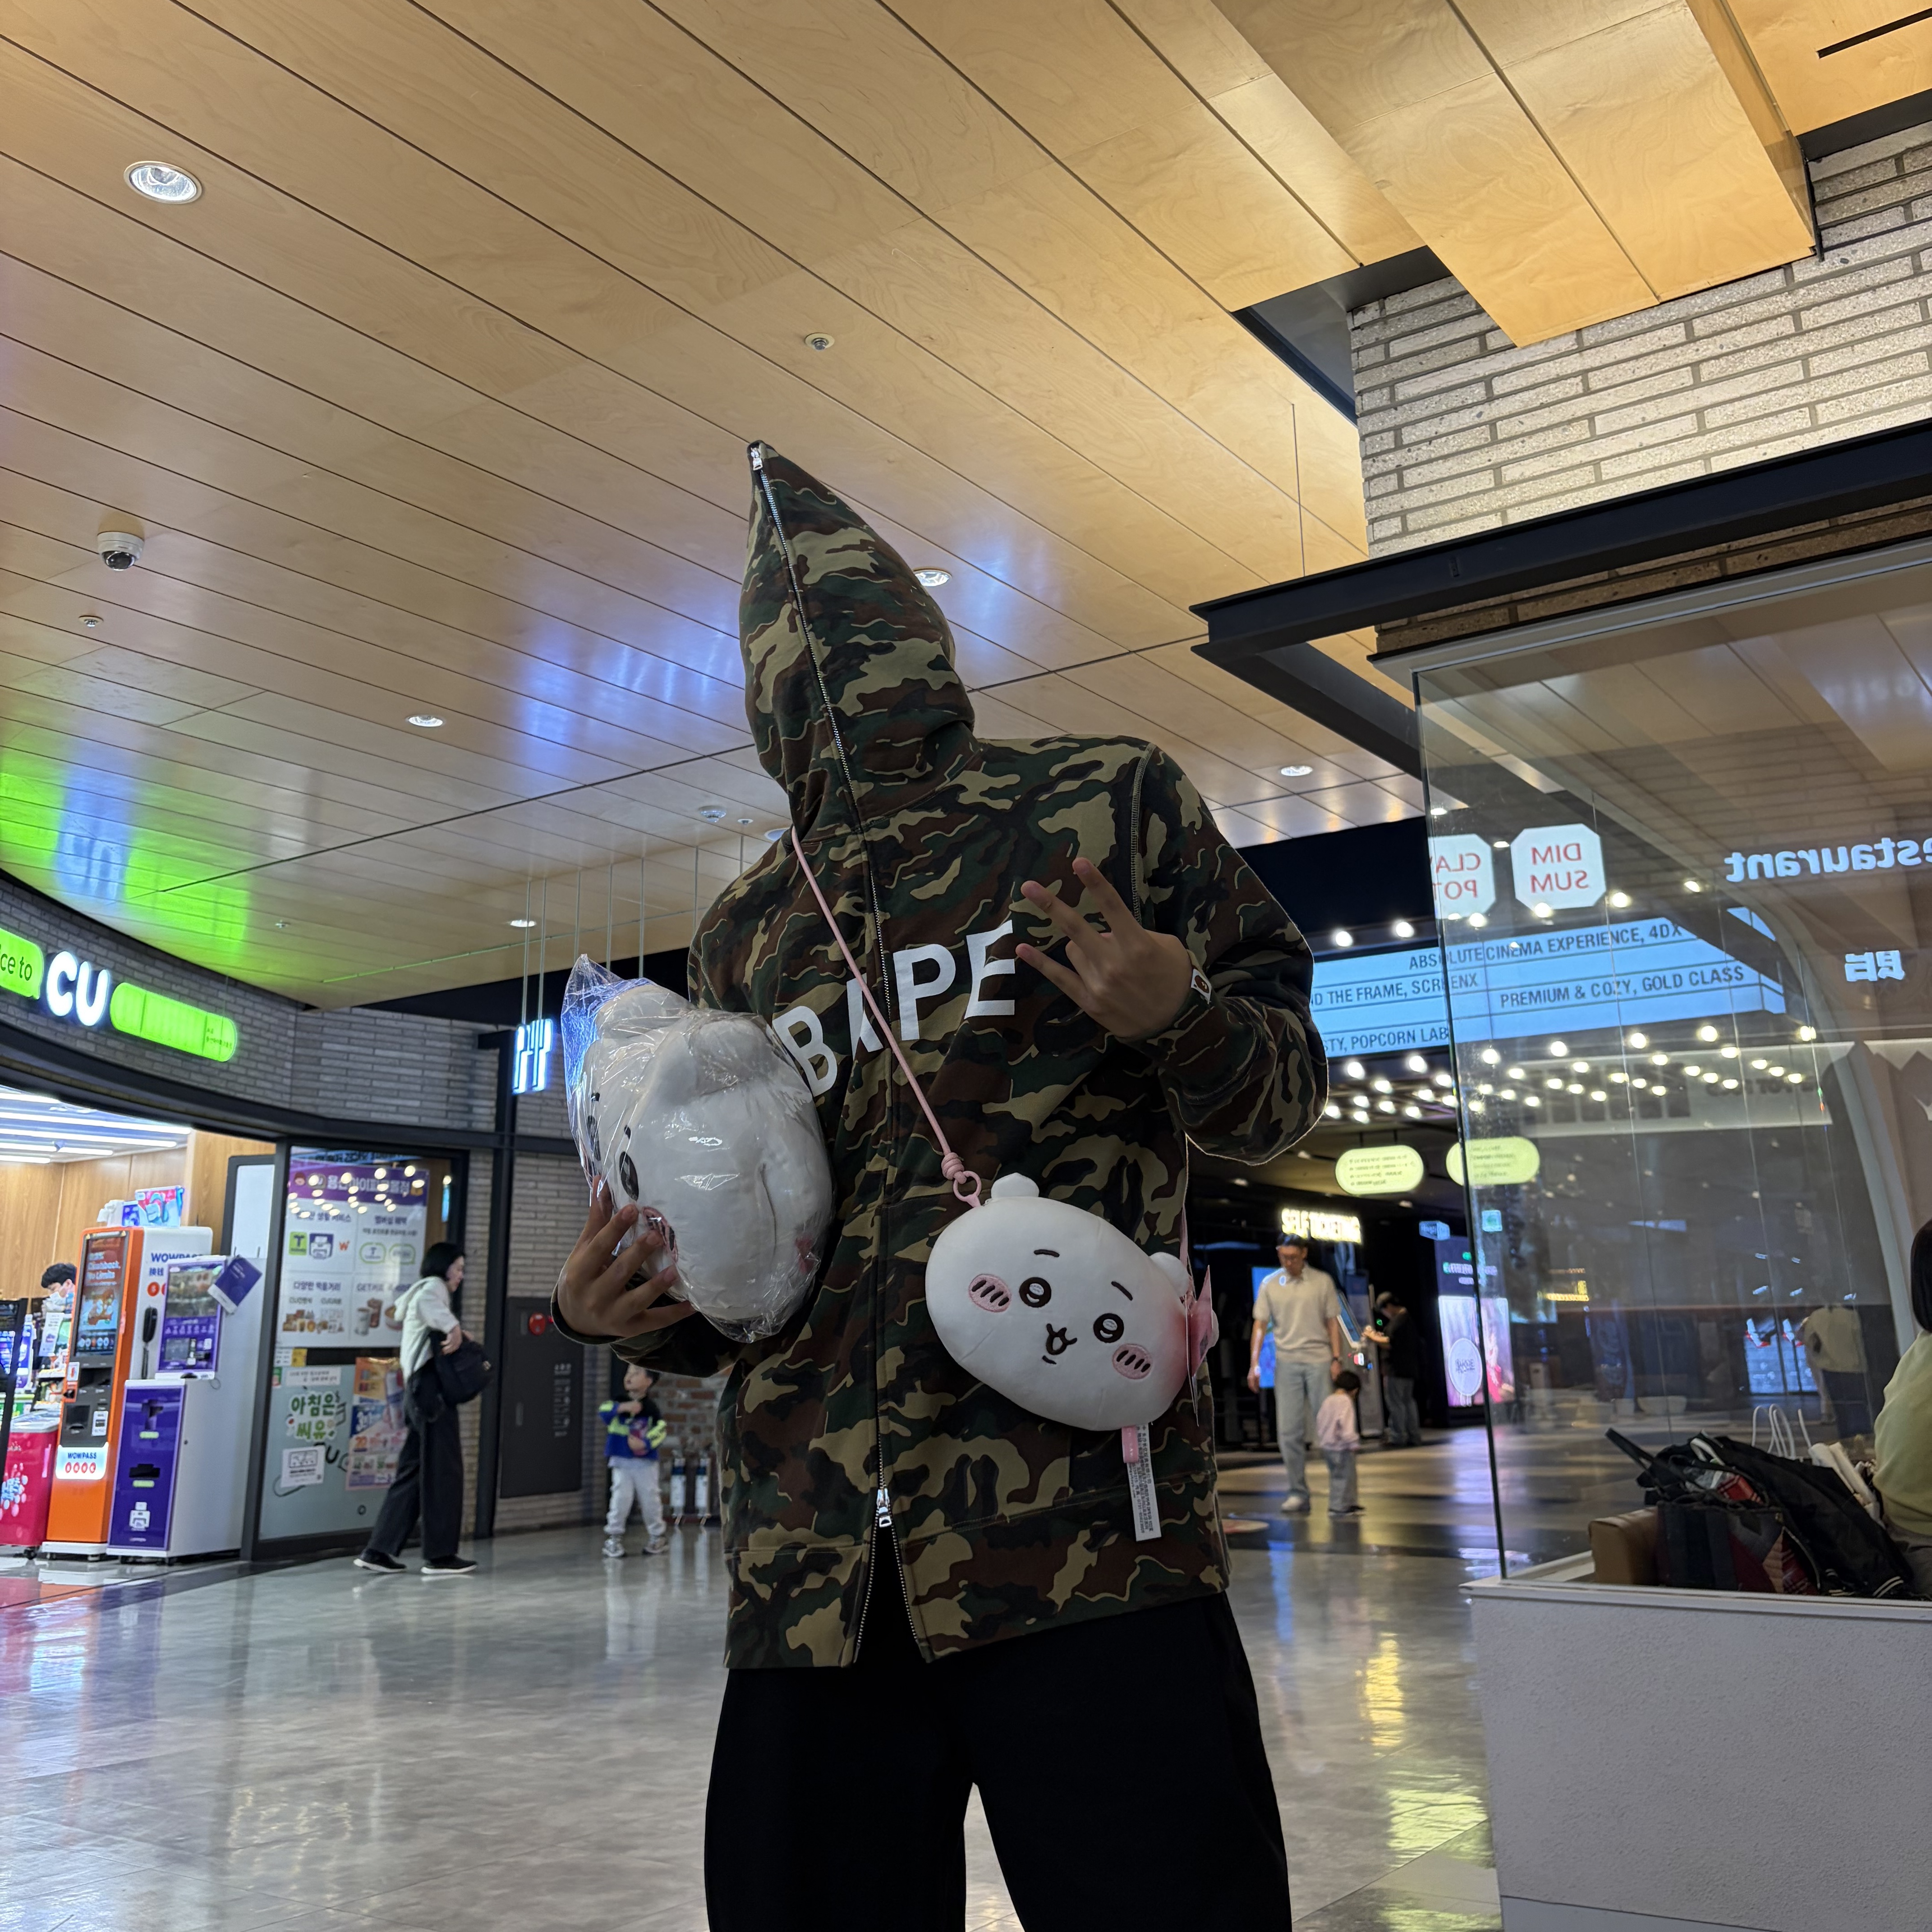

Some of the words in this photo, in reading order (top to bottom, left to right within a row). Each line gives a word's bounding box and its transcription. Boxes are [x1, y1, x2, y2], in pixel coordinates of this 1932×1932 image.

[1486, 941, 1543, 961] CINEMA
[1547, 927, 1644, 953] EXPERIENCE,
[1649, 923, 1682, 939] 4DX
[19, 956, 32, 981] to
[46, 951, 109, 1026] CU
[1327, 988, 1352, 1005] THE
[1356, 982, 1408, 1001] FRAME,
[1412, 973, 1479, 994] SCRENX
[1500, 987, 1570, 1008] PREMIUM
[1574, 986, 1586, 1000] &
[1591, 979, 1637, 997] COZY,
[1642, 973, 1683, 992] GOLD
[1688, 965, 1744, 986] CLASS
[1351, 1029, 1416, 1050] POPCORN
[1421, 1027, 1448, 1042] LAB
[291, 1394, 335, 1416] 아침은
[296, 1420, 326, 1440] 씨유
